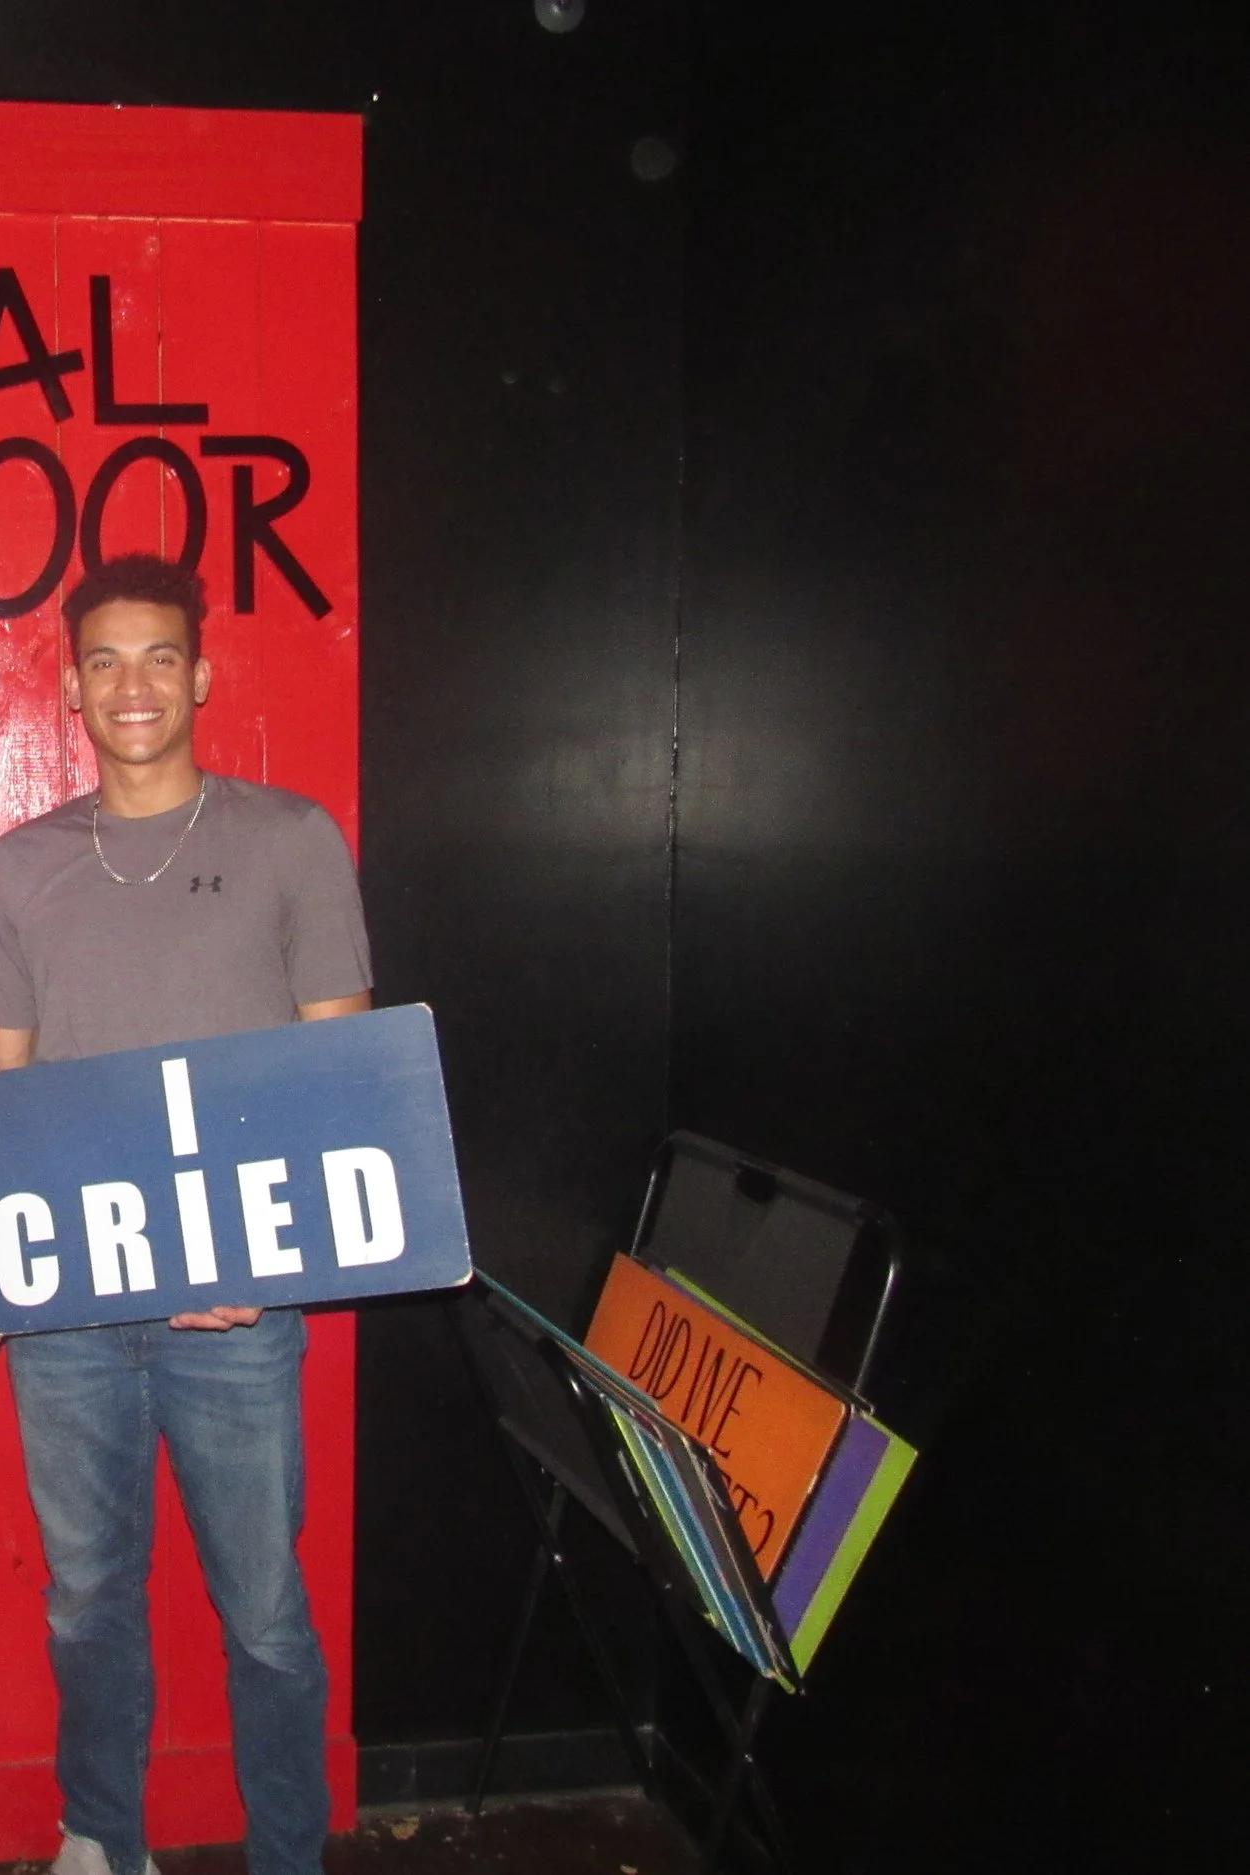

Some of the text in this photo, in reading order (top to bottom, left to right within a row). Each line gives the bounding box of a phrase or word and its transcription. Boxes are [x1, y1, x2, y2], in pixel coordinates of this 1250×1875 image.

[161, 1058, 198, 1157] I
[628, 1300, 763, 1458] DID WE
